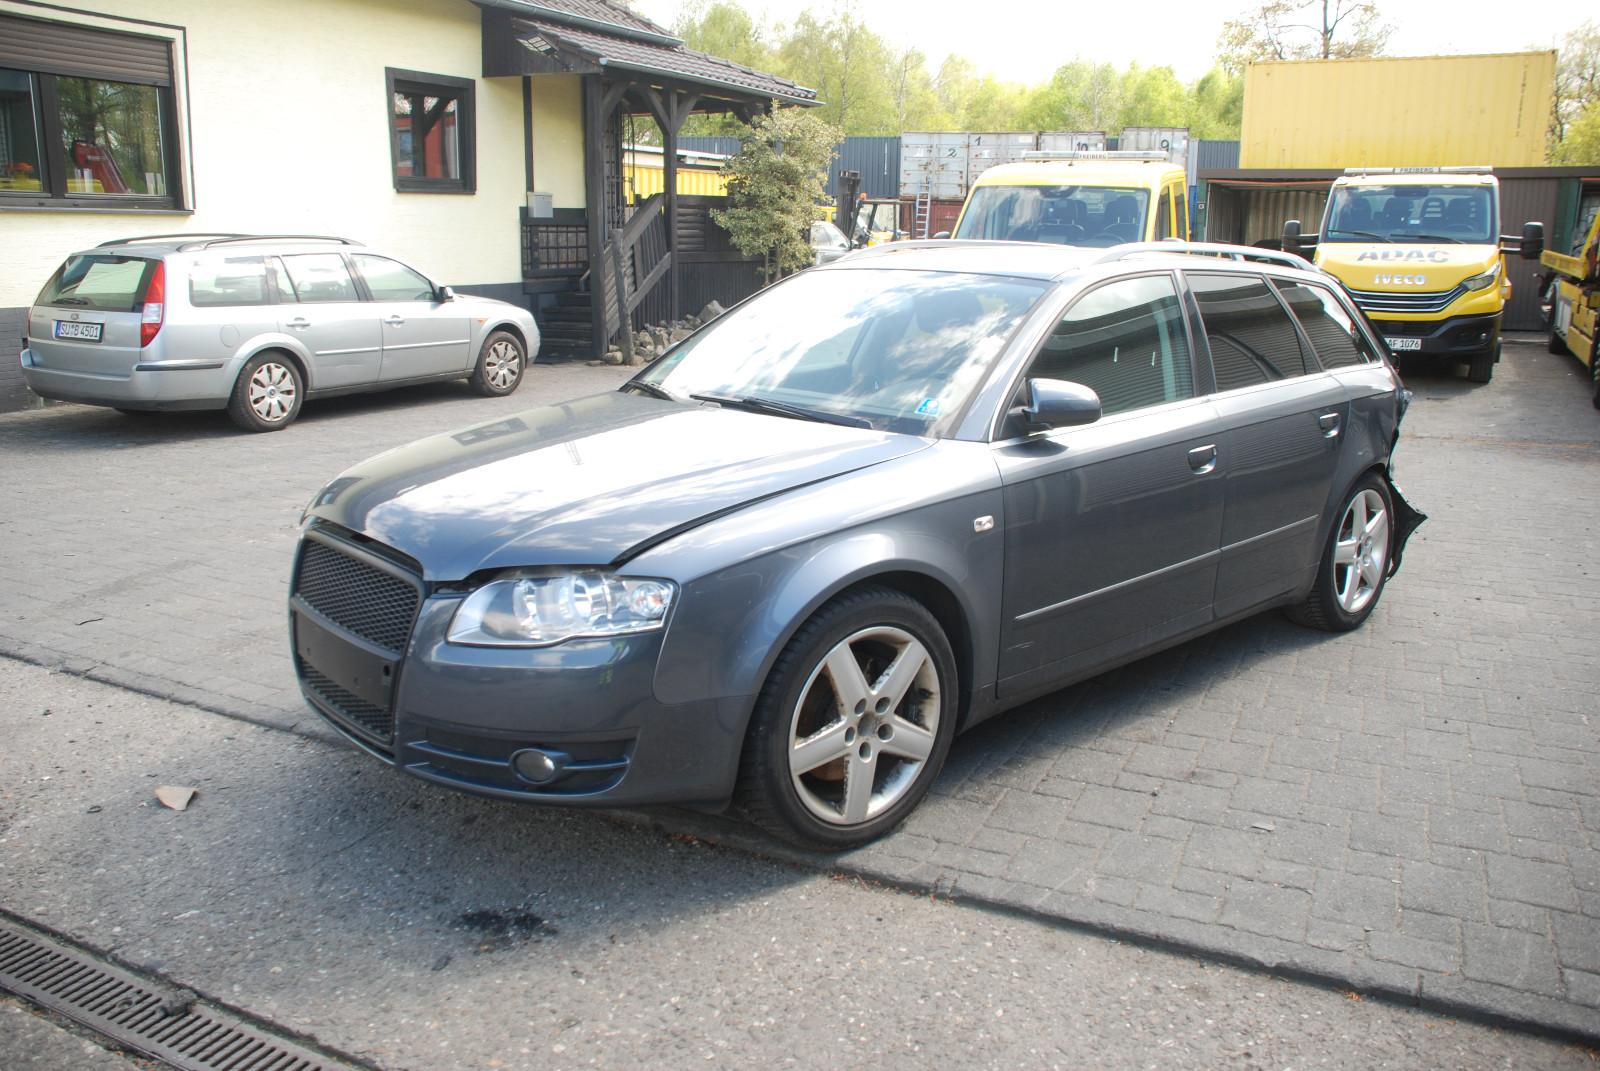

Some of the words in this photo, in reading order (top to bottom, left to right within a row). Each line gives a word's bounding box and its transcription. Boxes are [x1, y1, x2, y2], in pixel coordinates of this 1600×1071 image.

[1160, 139, 1169, 152] 9
[1357, 249, 1449, 263] ADAC
[1374, 273, 1426, 285] IVECO
[80, 325, 99, 338] 4501
